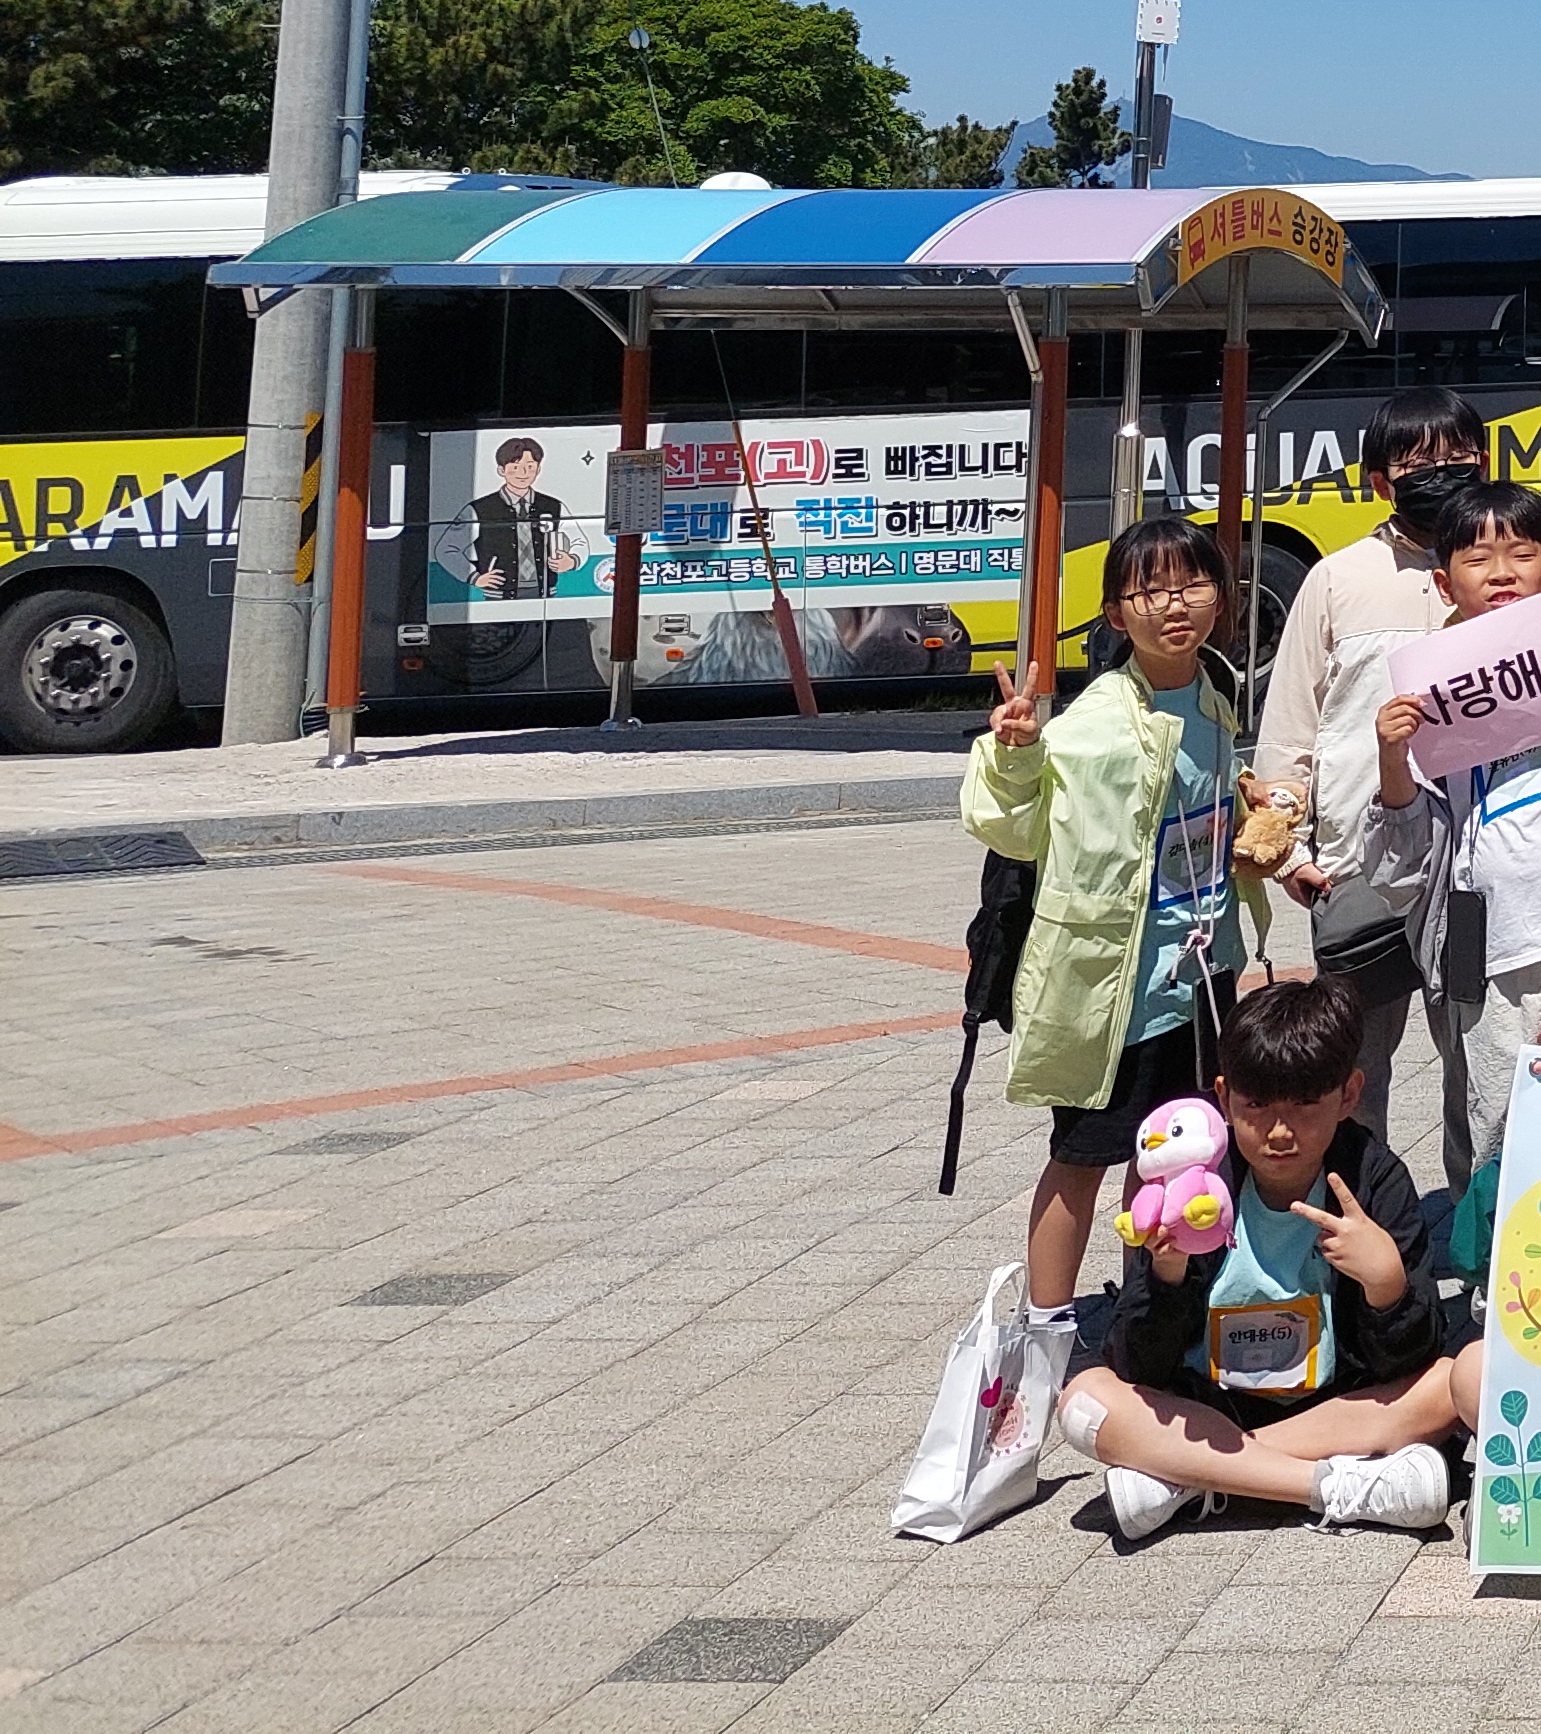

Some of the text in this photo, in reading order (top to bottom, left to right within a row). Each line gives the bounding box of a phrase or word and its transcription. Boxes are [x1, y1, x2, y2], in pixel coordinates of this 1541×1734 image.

[1211, 197, 1339, 267] 셔틀버스 승강장
[662, 438, 1027, 488] 천포(고)로 빠집니다
[795, 496, 877, 537] 직진
[640, 557, 798, 585] 삼천포고등학교
[803, 552, 895, 580] 통학버스
[913, 549, 981, 574] 명문대
